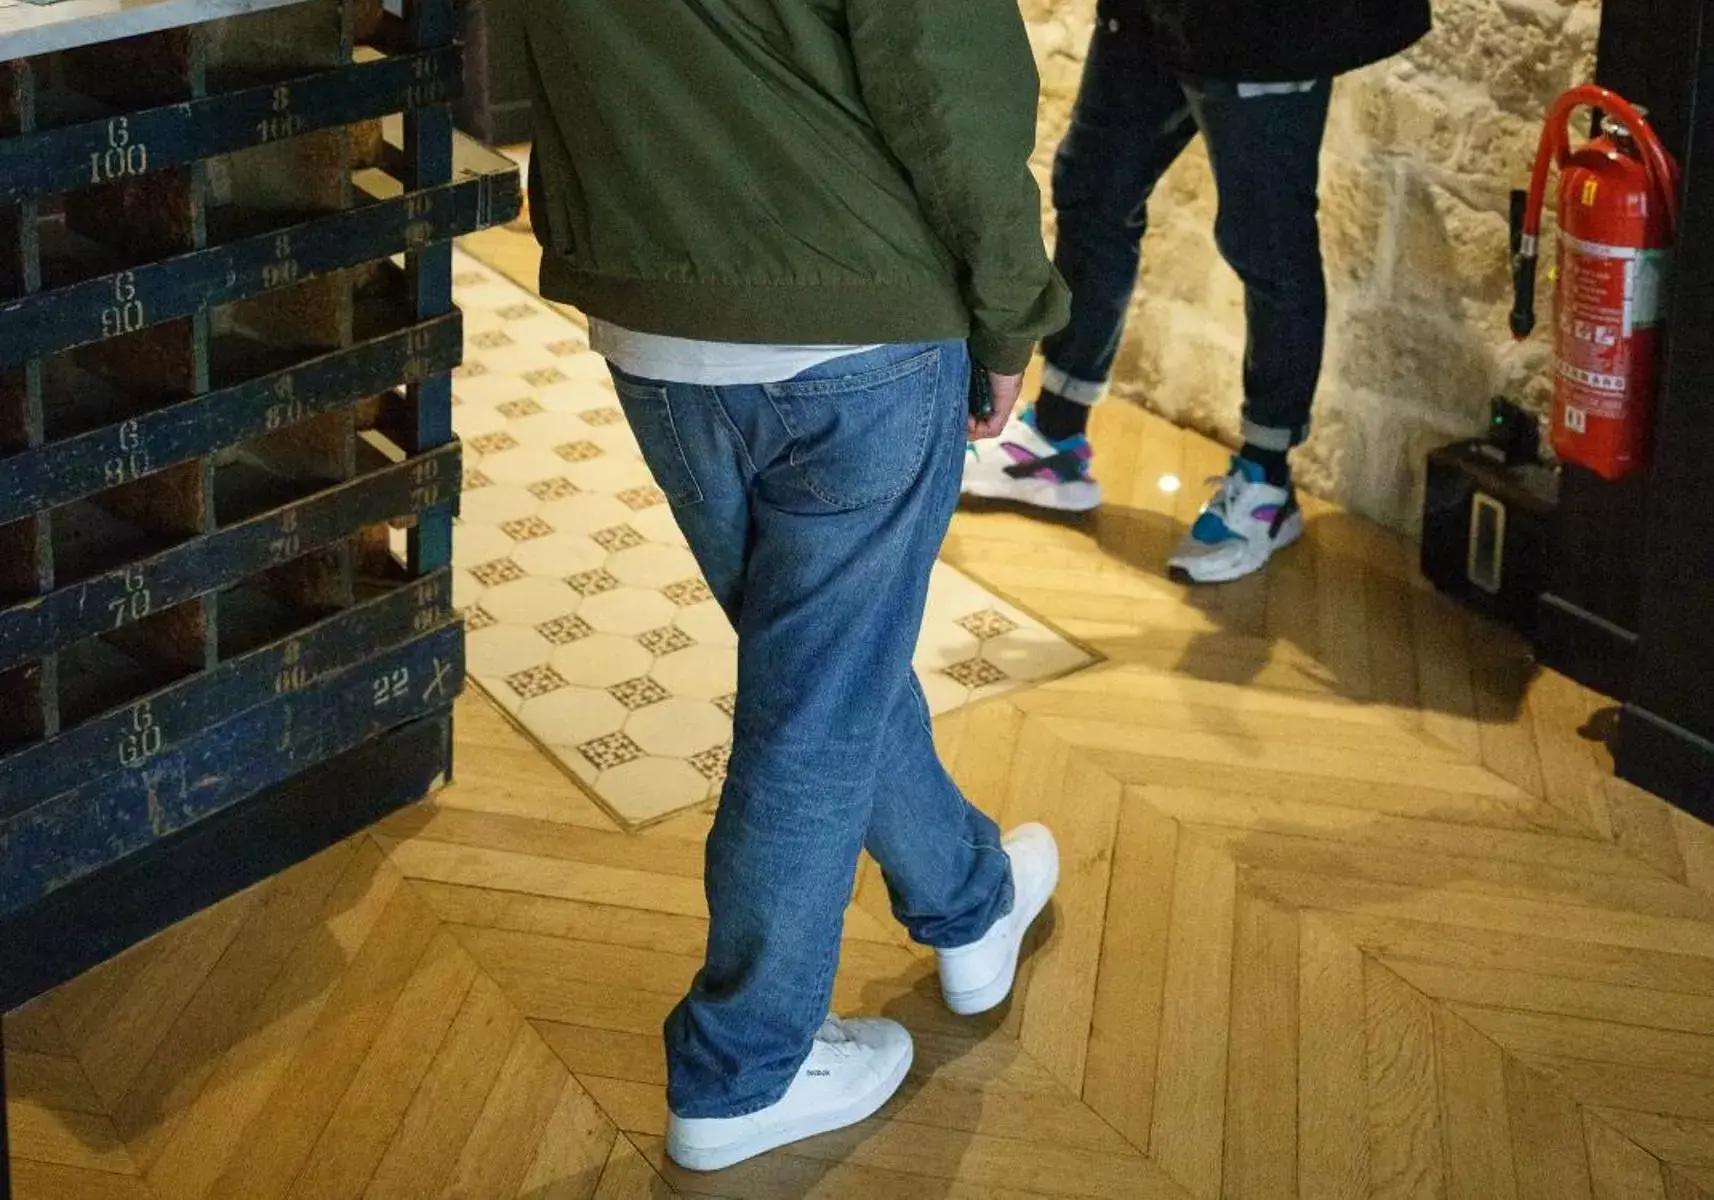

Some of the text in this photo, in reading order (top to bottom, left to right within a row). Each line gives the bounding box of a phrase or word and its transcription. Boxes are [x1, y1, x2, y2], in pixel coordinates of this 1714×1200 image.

[89, 142, 148, 184] 100
[108, 588, 150, 628] 70
[373, 666, 409, 706] 22
